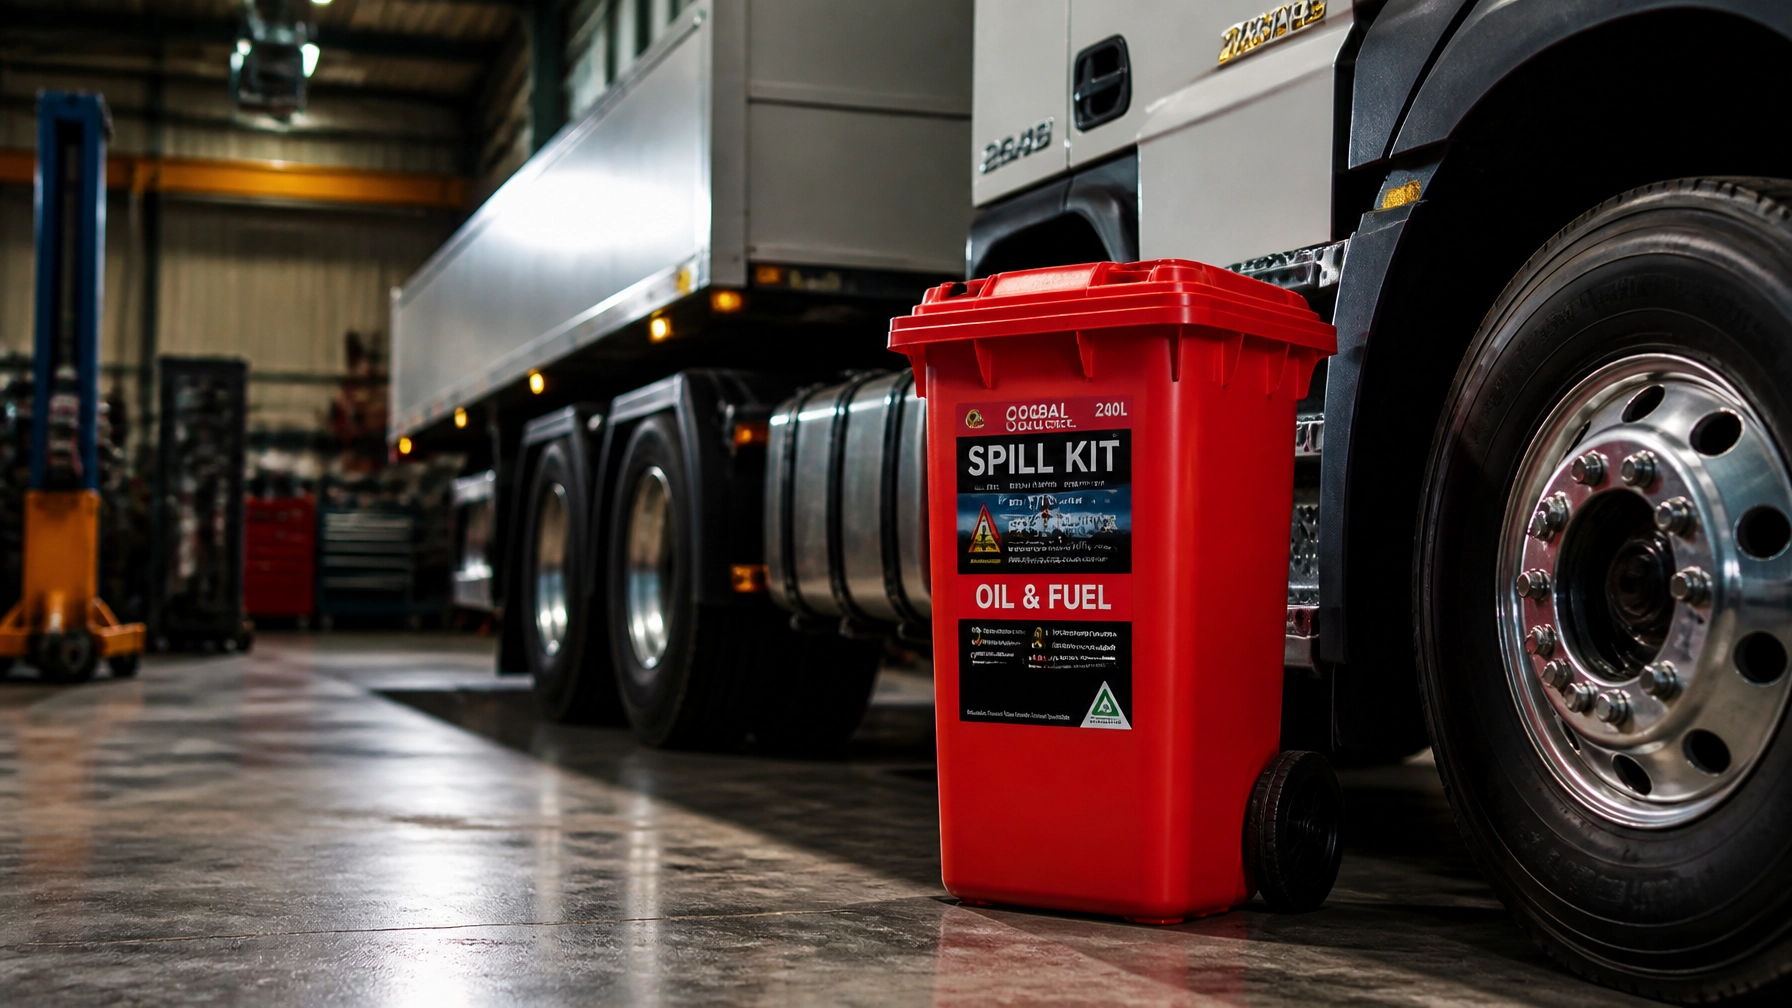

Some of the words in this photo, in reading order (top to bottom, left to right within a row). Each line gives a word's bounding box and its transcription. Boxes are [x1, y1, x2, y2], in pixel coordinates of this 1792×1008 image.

[967, 442, 1054, 476] SPILL
[1065, 439, 1120, 473] KIT
[975, 583, 1015, 609] OIL
[1022, 583, 1040, 609] &
[1048, 583, 1112, 610] FUEL
